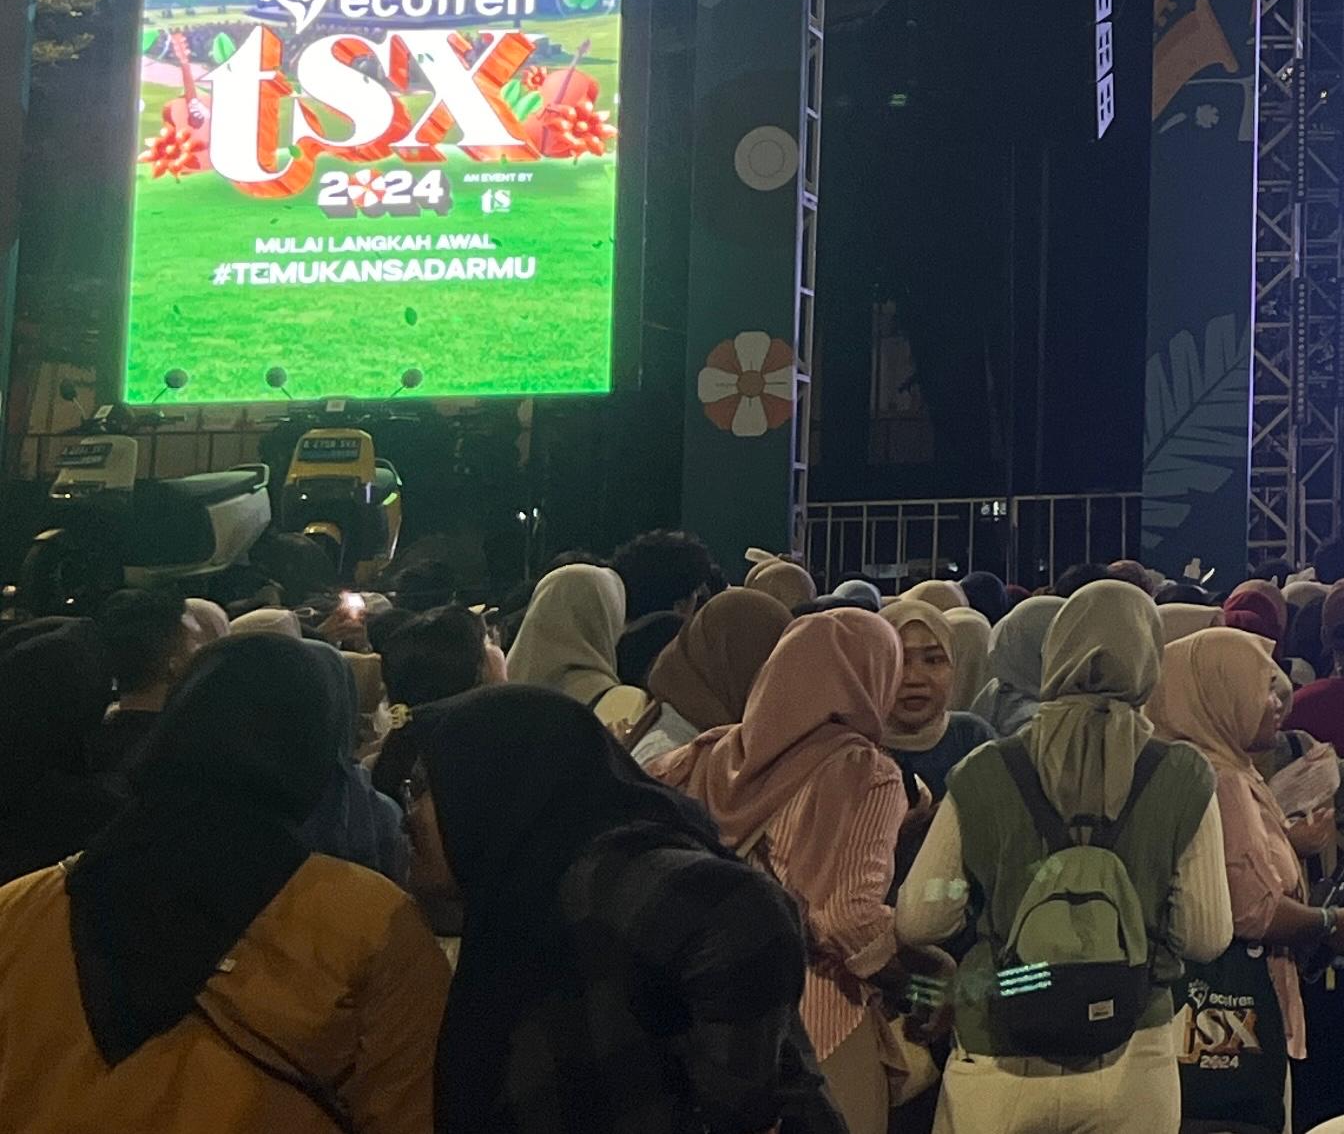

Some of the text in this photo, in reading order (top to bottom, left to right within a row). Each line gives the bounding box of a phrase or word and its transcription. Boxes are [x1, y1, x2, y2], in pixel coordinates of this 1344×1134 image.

[255, 233, 496, 254] MULAI LANGKAH AWAL
[212, 256, 536, 285] #TEMUKANSADARMU
